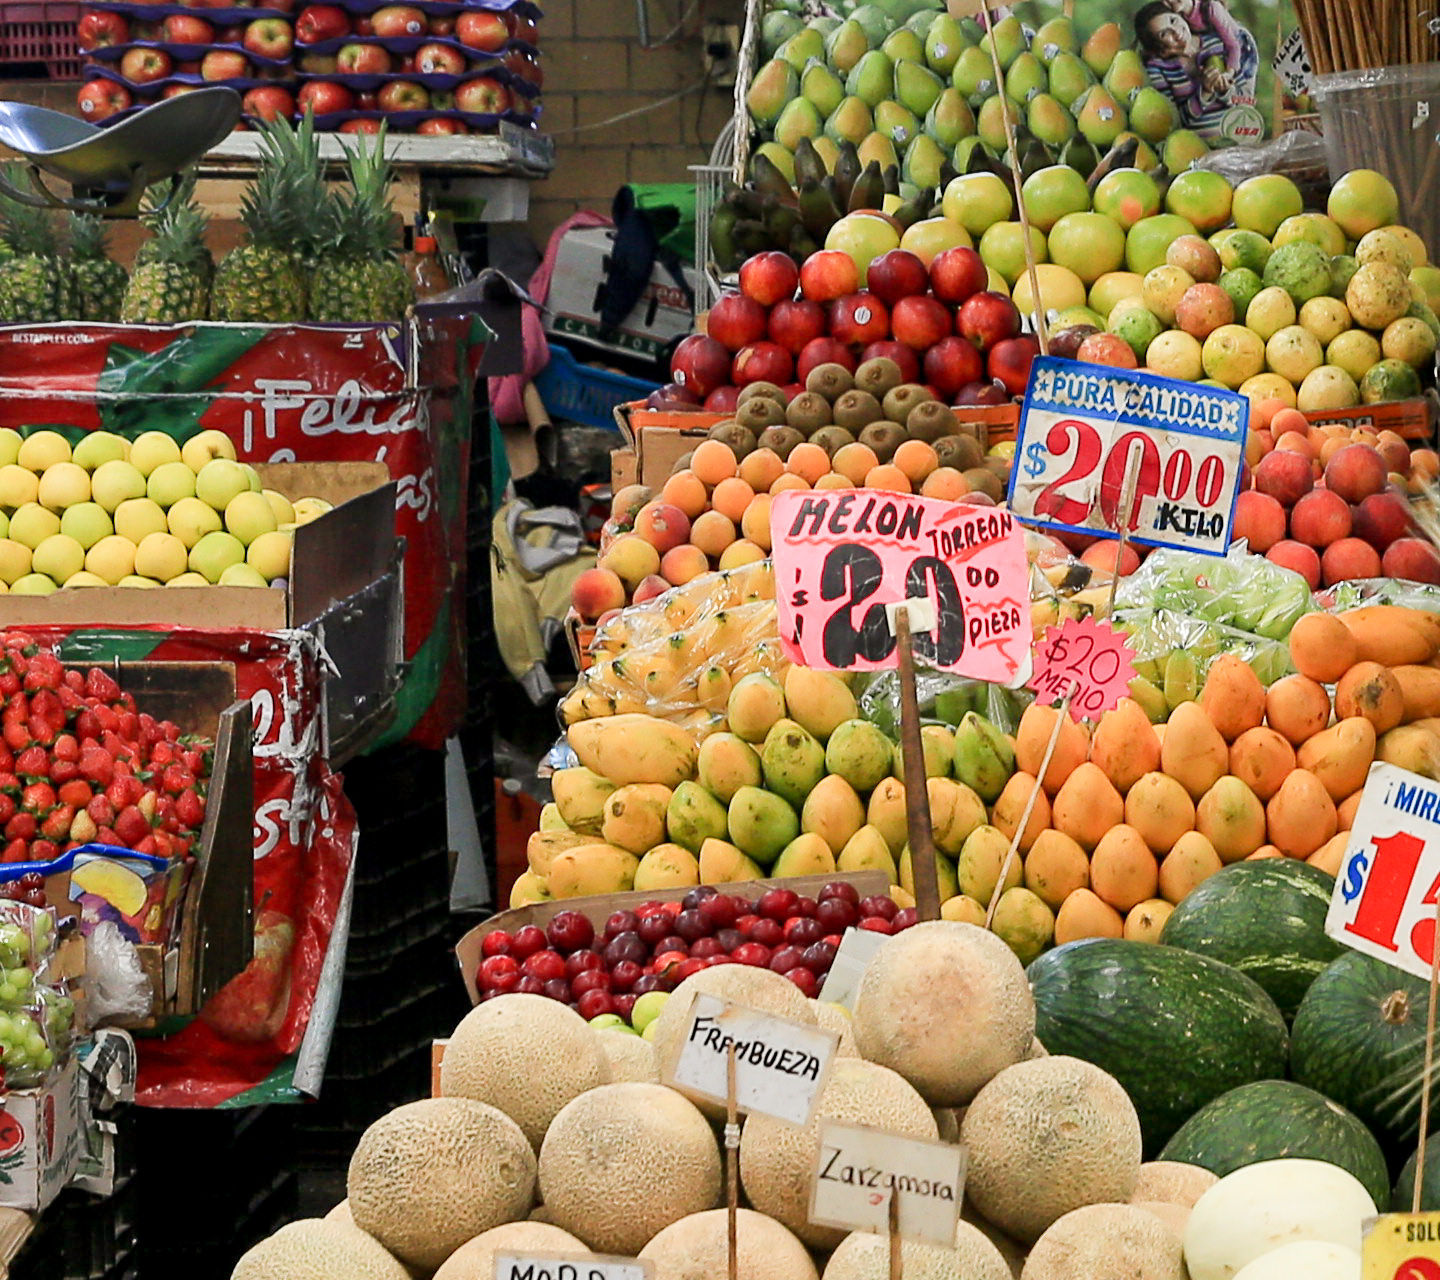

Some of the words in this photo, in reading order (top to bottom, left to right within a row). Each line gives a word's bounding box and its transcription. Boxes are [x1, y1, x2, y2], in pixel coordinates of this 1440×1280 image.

[1051, 375, 1117, 408] PURA
[1124, 387, 1224, 425] CALIDAD
[1163, 448, 1225, 508] 00
[789, 495, 926, 541] MELON
[925, 513, 1013, 559] TORREON
[1156, 501, 1225, 542] KILO
[819, 542, 966, 668] 20
[968, 607, 1022, 648] PIEZA
[1045, 633, 1121, 686] $20
[1033, 666, 1105, 713] MEDIO
[689, 1016, 821, 1083] FRAMBUEZA
[819, 1147, 955, 1204] Zarzamora
